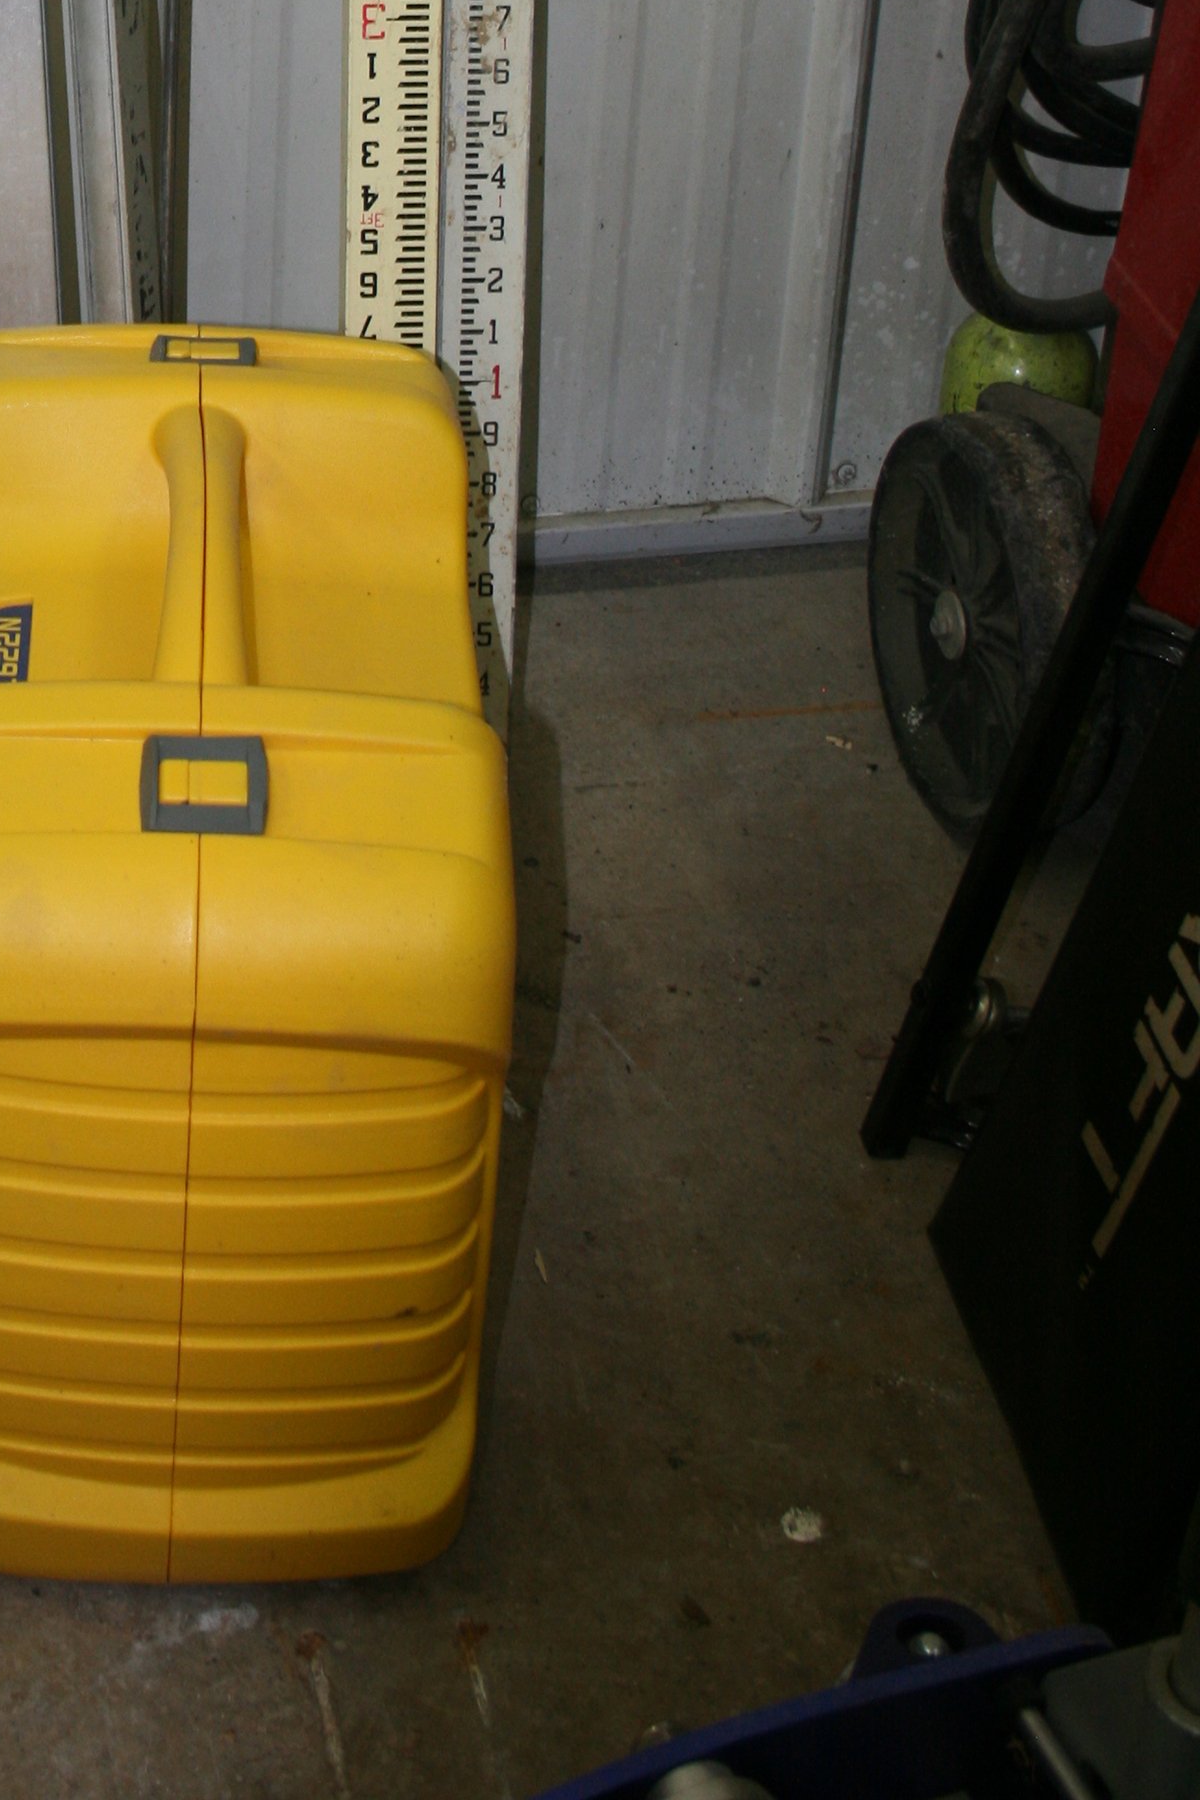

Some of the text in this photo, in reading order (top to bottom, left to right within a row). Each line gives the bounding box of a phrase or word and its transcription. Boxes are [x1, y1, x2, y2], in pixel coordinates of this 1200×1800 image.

[362, 1, 386, 40] 3
[495, 5, 511, 32] 7
[366, 52, 377, 80] 1
[493, 58, 510, 84] 6
[362, 97, 380, 124] 2
[492, 110, 508, 137] 5
[361, 140, 379, 168] 3
[490, 163, 506, 190] 4
[361, 185, 379, 212] 4
[360, 228, 379, 255] 5
[489, 215, 505, 241] 3
[359, 272, 378, 298] 6
[487, 267, 503, 293] 2
[488, 318, 498, 345] 1
[491, 364, 502, 399] 1
[483, 421, 498, 447] 9
[481, 471, 497, 497] 8
[480, 522, 495, 547] 7
[477, 572, 494, 598] 6
[476, 622, 492, 647] 5
